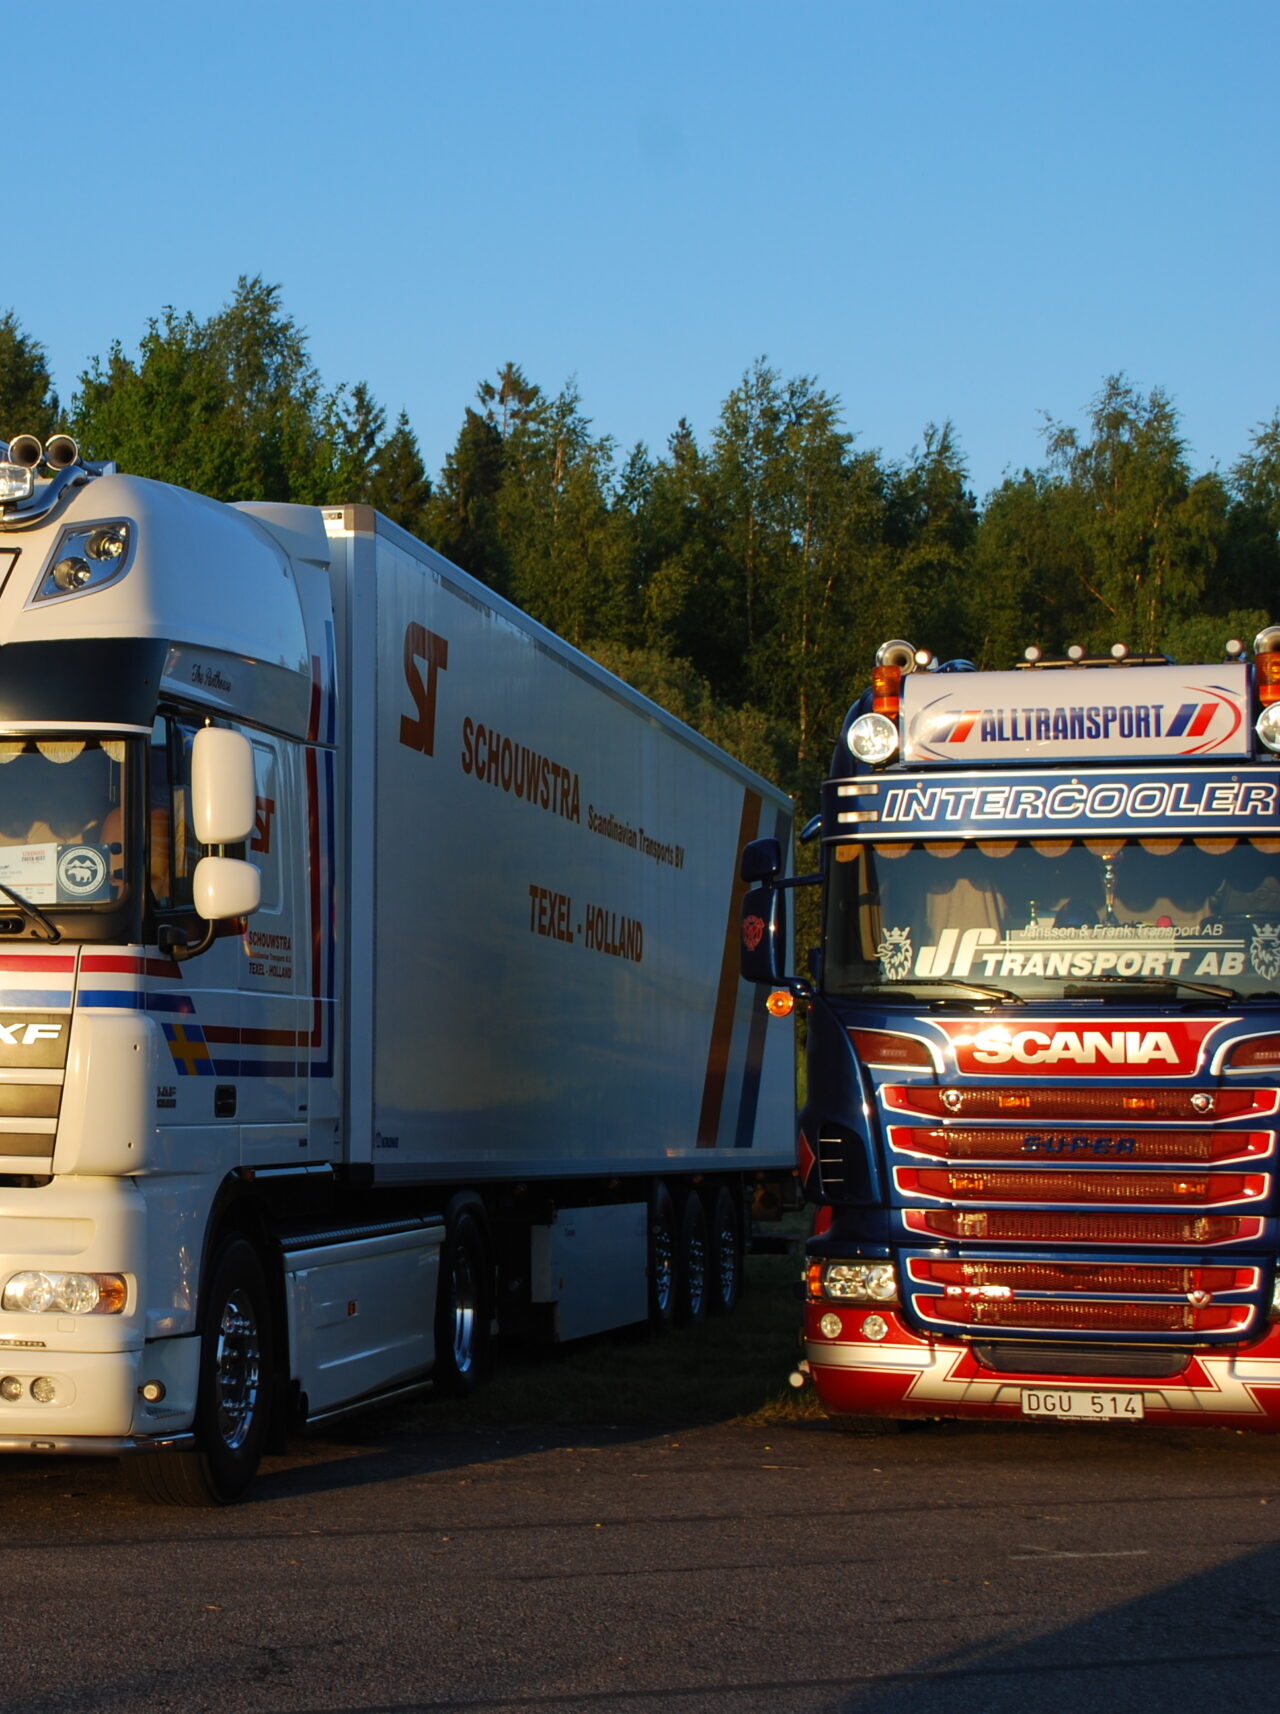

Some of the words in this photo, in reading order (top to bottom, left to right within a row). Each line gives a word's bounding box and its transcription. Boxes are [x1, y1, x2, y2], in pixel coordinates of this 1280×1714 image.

[980, 704, 1164, 742] ALLTRANSPORT
[461, 716, 580, 825] SCHOUWSTRA
[586, 803, 638, 849] Scandinavian
[638, 826, 673, 867] Transports
[674, 844, 685, 869] BV
[881, 782, 1277, 822] INTERCOOLER
[528, 883, 574, 944] TEXEL
[585, 904, 643, 963] HOLLAND
[1020, 924, 1076, 937] Jansson
[1092, 924, 1132, 937] Frank
[1136, 924, 1199, 939] Transport
[1202, 923, 1223, 936] AB
[249, 931, 291, 950] SCHOUWSTRA
[982, 952, 1191, 977] TRANSPORT
[1195, 952, 1245, 976] AB
[971, 1031, 1180, 1064] SCANIA
[1023, 1135, 1135, 1154] SUPER
[1028, 1393, 1071, 1412] DGU
[1091, 1396, 1136, 1414] 514
